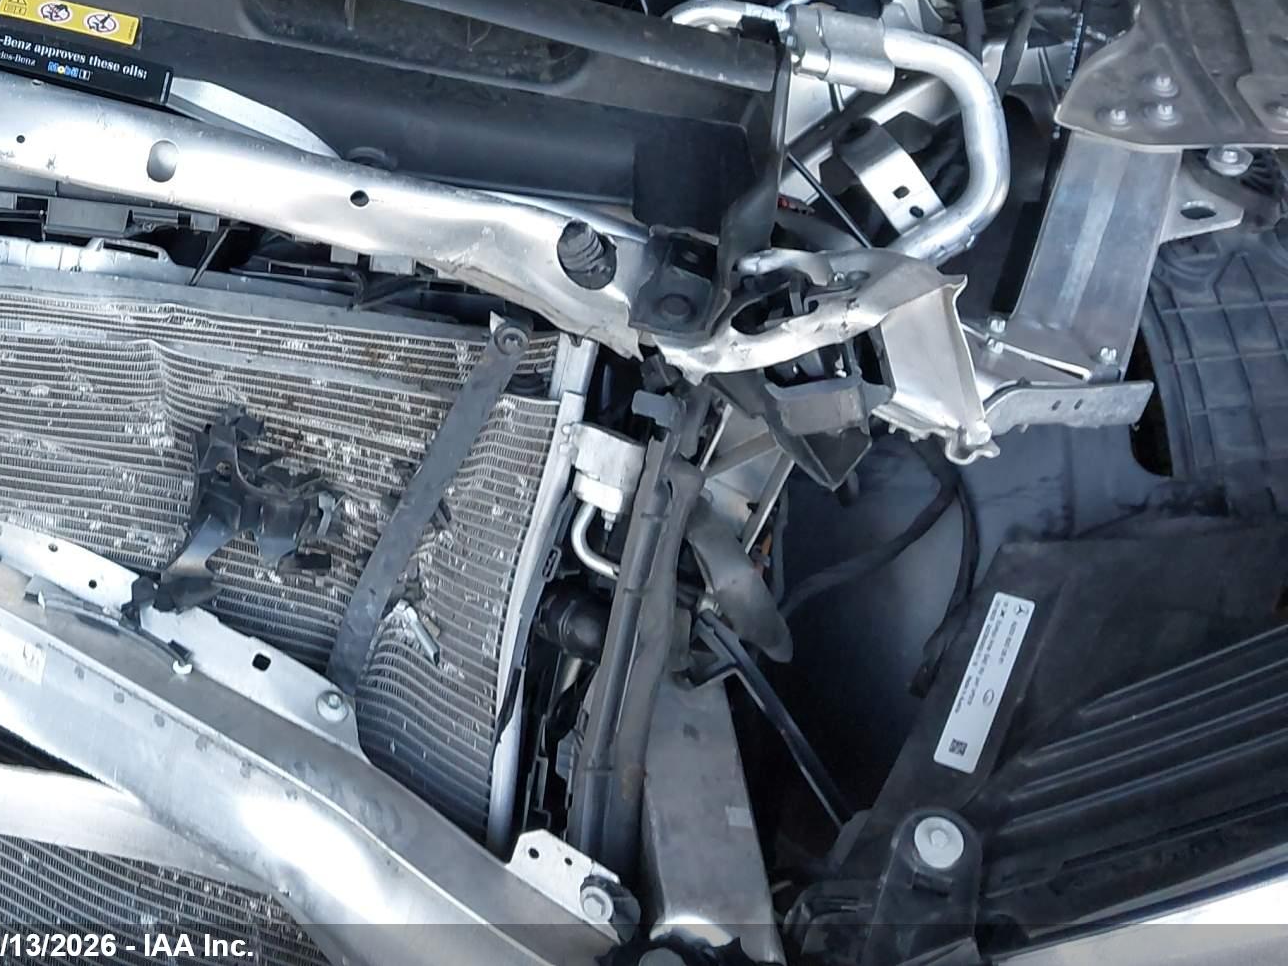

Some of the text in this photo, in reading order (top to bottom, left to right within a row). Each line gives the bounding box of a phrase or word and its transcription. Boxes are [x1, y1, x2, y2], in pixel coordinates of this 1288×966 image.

[34, 41, 87, 64] approves
[89, 55, 120, 72] these
[47, 61, 79, 78] Mobil
